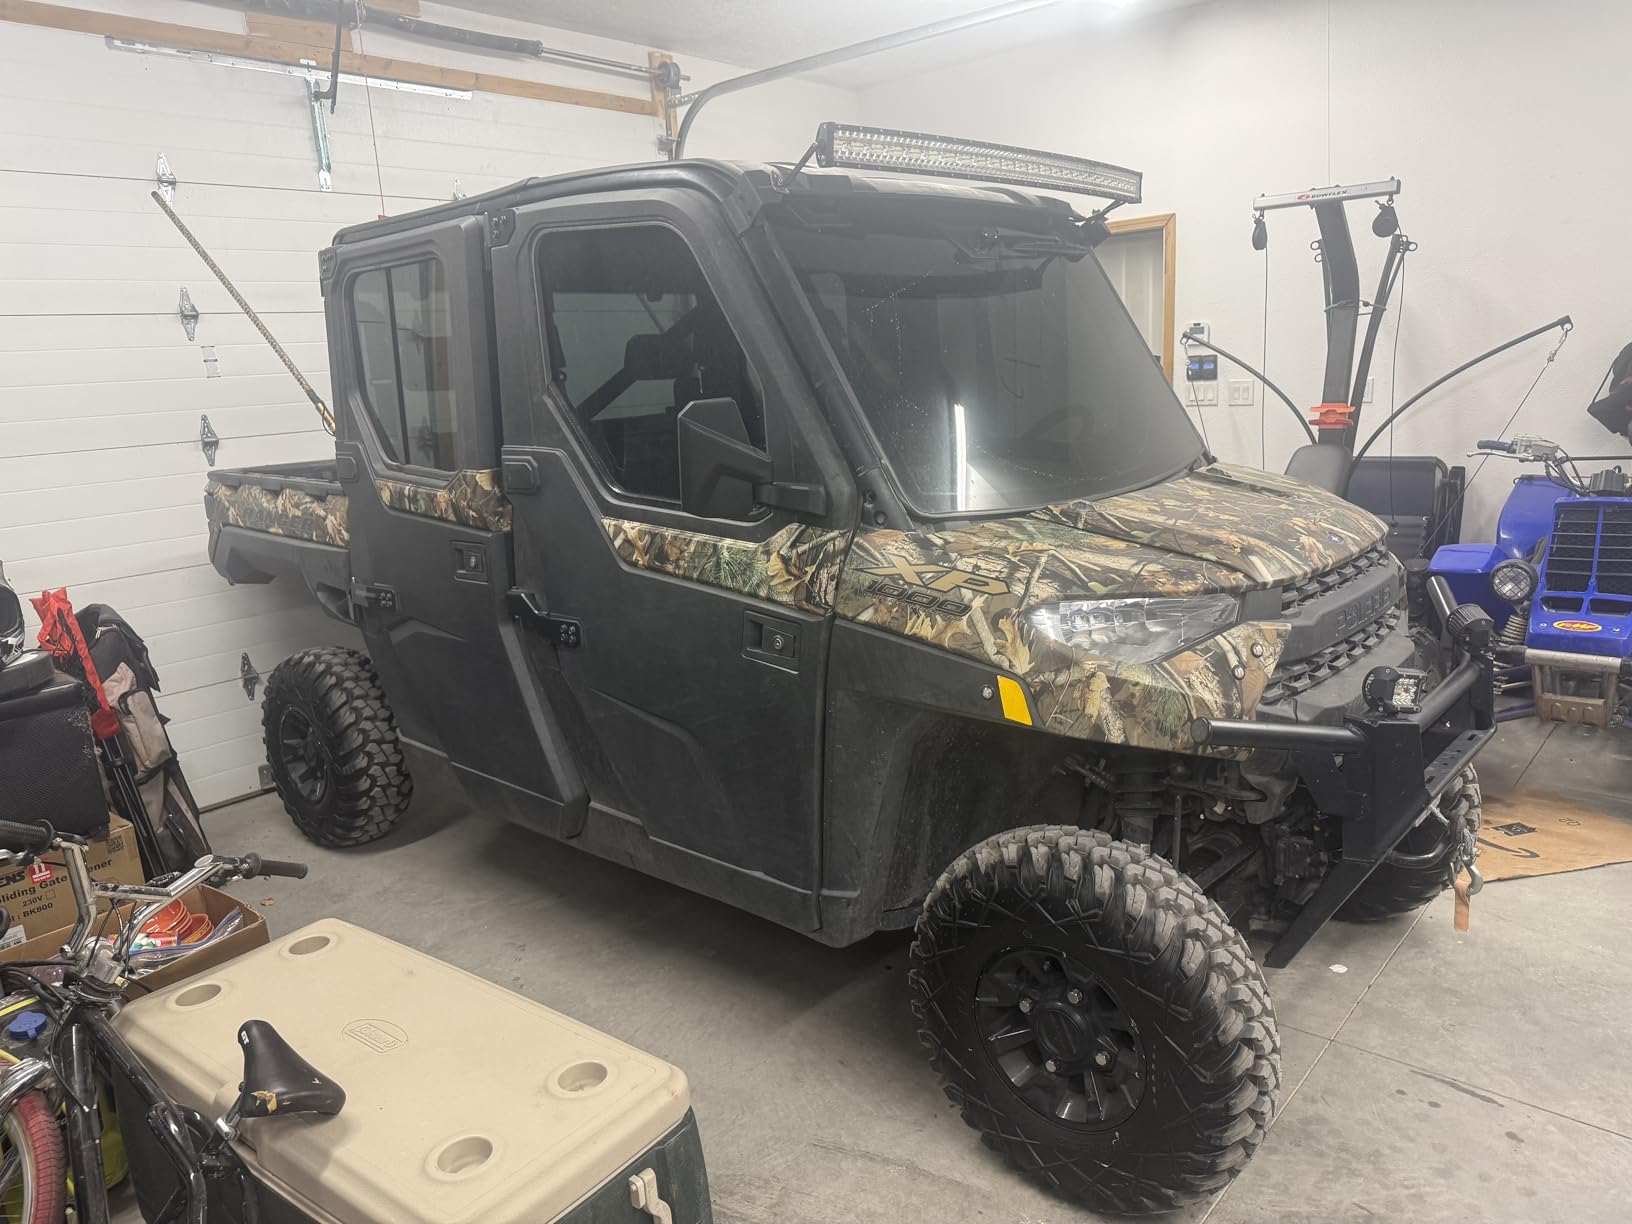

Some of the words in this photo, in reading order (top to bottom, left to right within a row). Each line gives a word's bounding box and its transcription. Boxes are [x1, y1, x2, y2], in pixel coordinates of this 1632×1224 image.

[1311, 190, 1348, 199] BOWFLEX
[852, 552, 1011, 595] XP
[864, 579, 972, 617] 1000
[0, 886, 36, 903] liding
[40, 875, 68, 889] Gate
[23, 902, 53, 918] BK800
